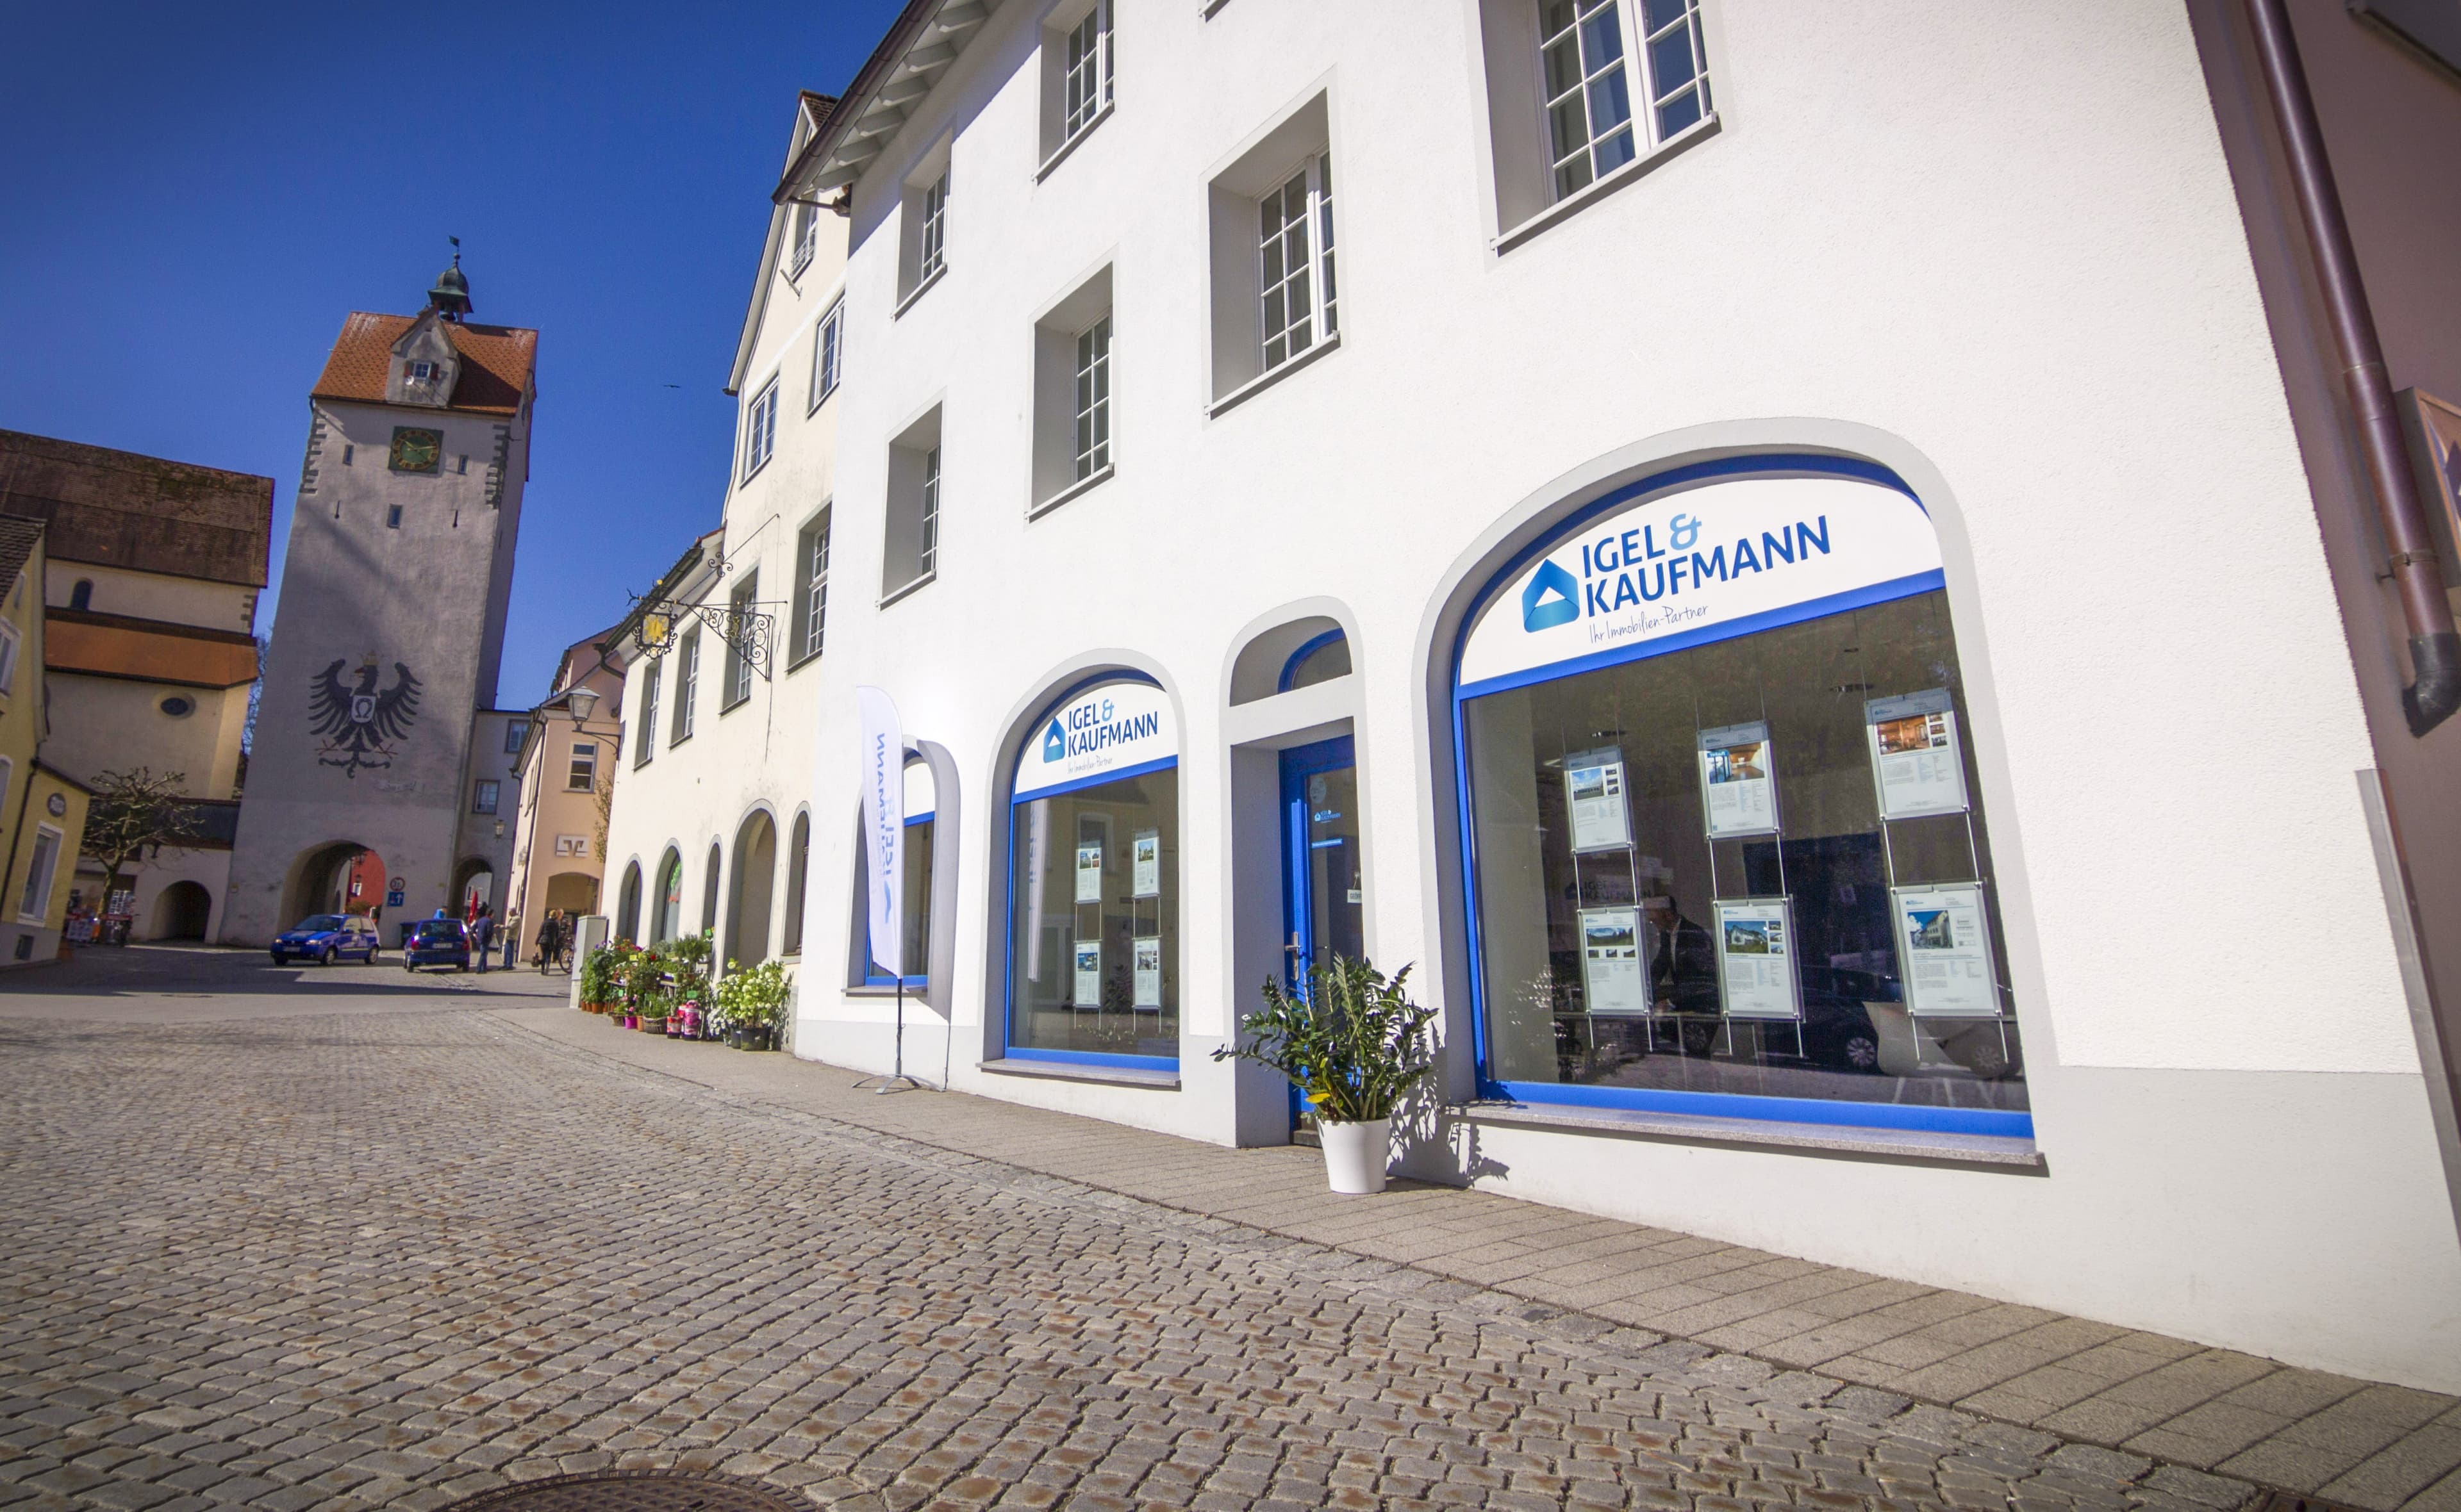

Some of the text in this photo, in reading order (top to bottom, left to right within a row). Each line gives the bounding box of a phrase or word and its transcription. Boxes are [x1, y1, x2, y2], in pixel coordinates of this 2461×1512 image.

[1582, 513, 1702, 579] IGEL &
[1586, 515, 1831, 618] KAUFMANN
[1589, 605, 1709, 644] Ihr Immobilien-Partner
[1068, 698, 1114, 732] IGEL &
[1068, 711, 1157, 757] KAUFMANN
